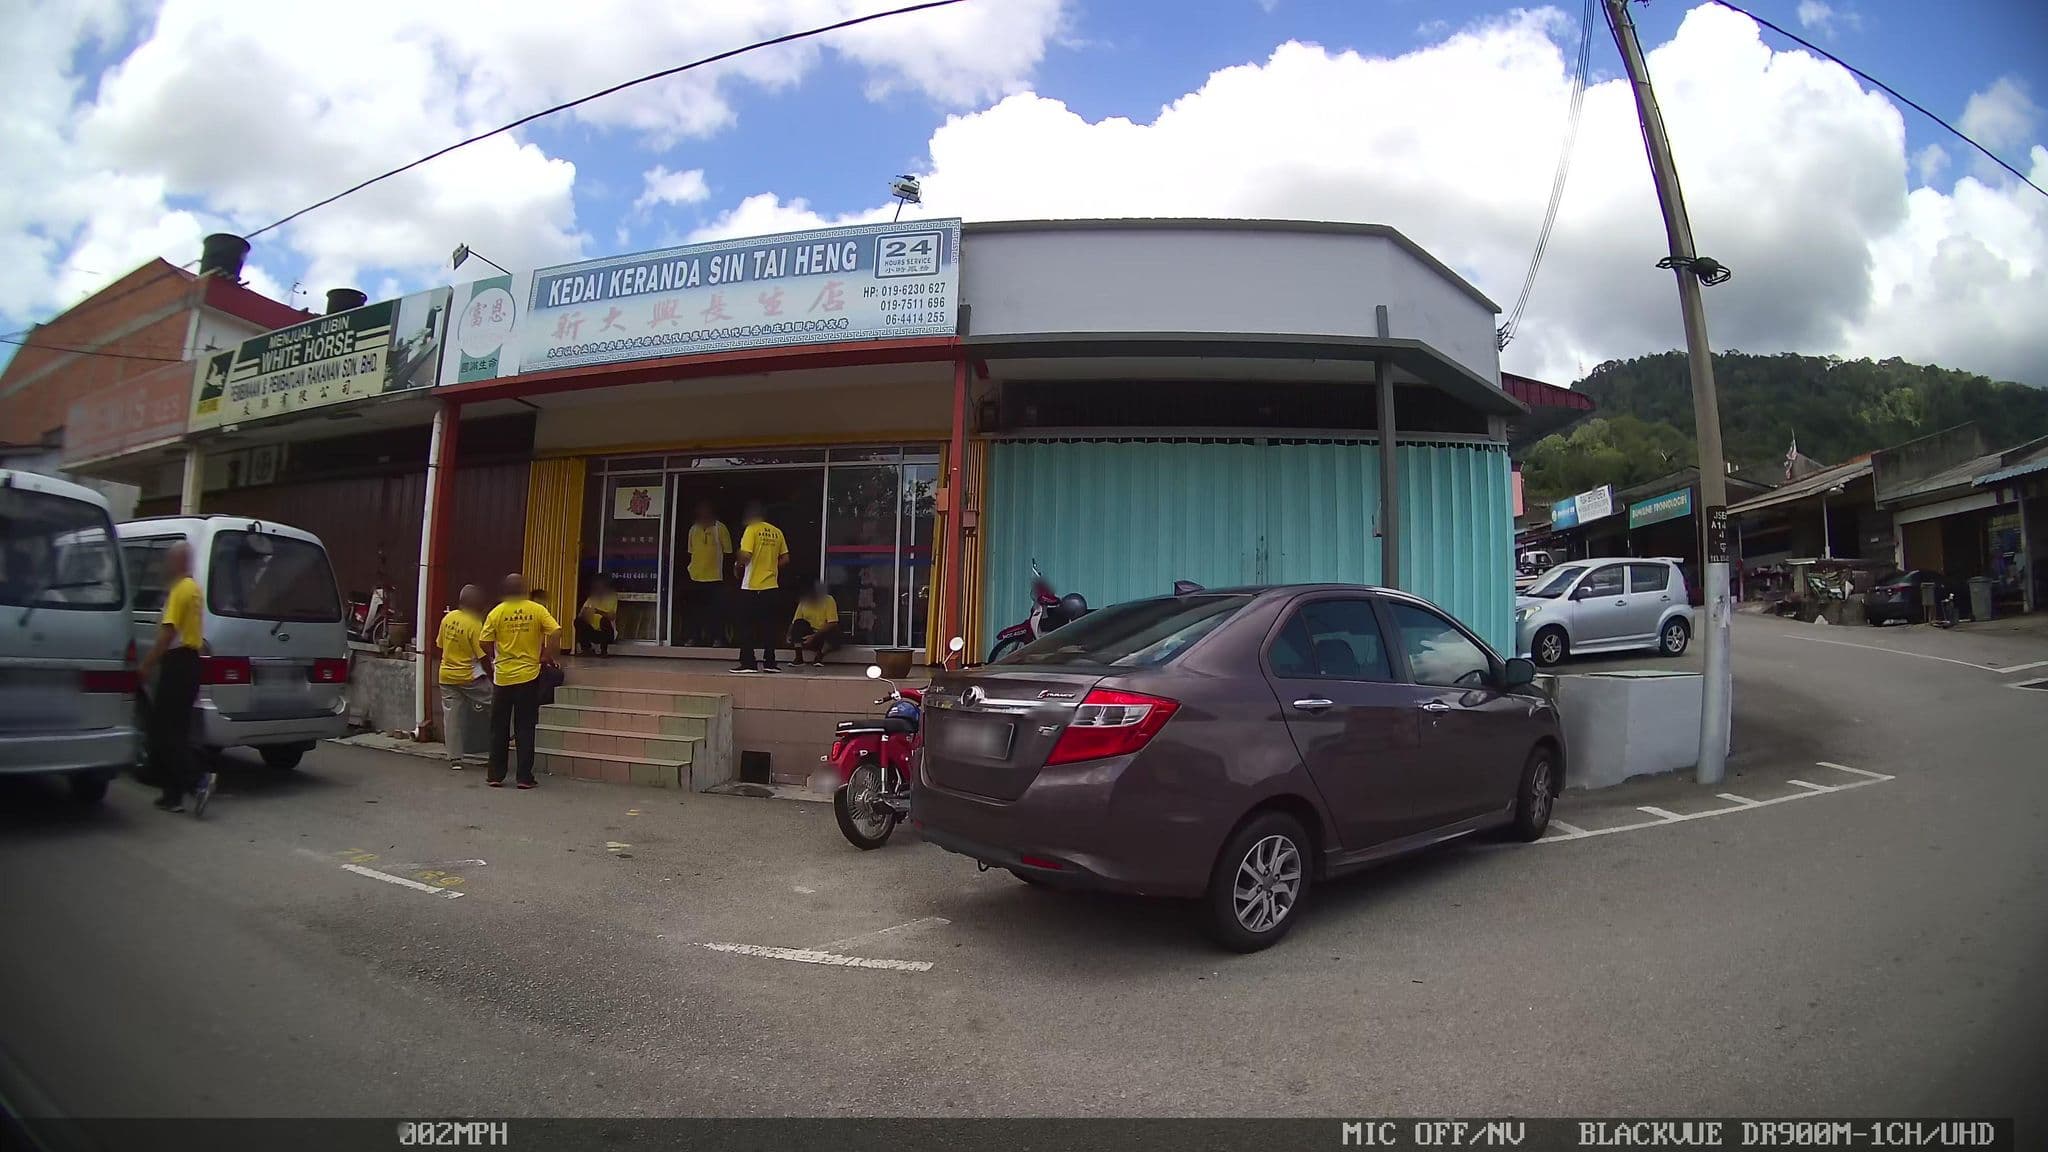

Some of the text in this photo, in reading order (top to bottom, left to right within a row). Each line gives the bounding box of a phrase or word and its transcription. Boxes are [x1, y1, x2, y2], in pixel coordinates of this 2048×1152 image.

[886, 240, 932, 257] 24
[884, 257, 932, 267] HOURS SERVICE
[548, 241, 858, 307] KEDAI KERANDA SIN TAI HENG
[863, 287, 879, 298] HP:
[929, 282, 946, 294] 627
[928, 297, 945, 309] 696
[927, 311, 945, 323] 255
[268, 315, 350, 348] MENJUAL JUBIN
[261, 330, 355, 373] WHITE HORSE
